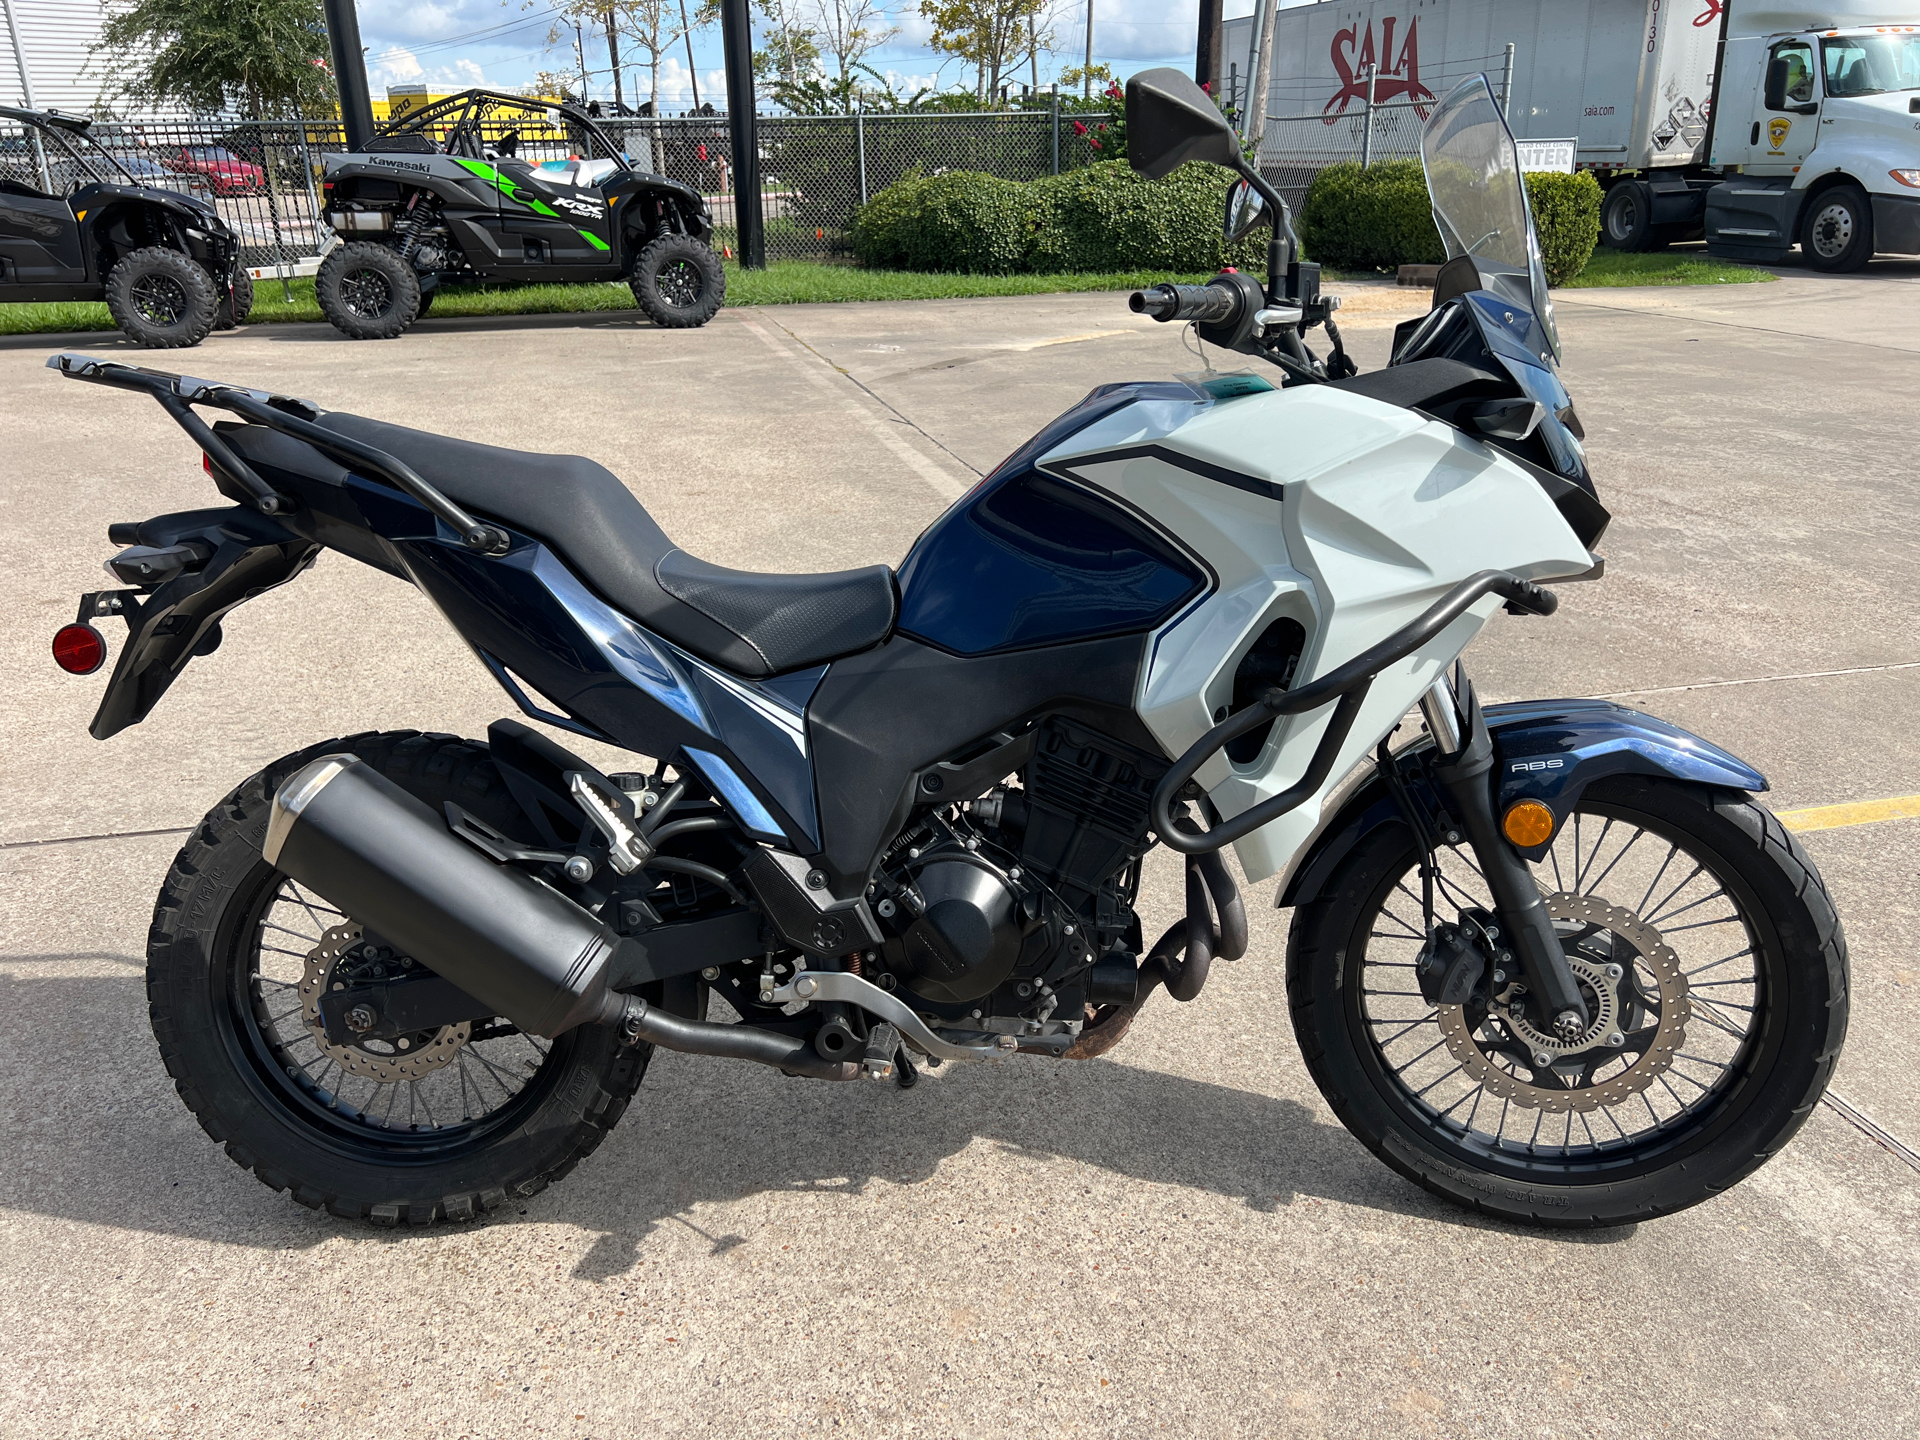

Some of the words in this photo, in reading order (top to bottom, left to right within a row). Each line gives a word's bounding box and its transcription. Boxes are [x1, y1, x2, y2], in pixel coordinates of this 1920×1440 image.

[1330, 14, 1419, 86] SAIA
[1584, 104, 1615, 117] saia.com
[368, 155, 432, 174] Kawasaki
[552, 197, 605, 215] KRX
[1511, 759, 1564, 773] ABS
[916, 928, 958, 973] Kawasaki
